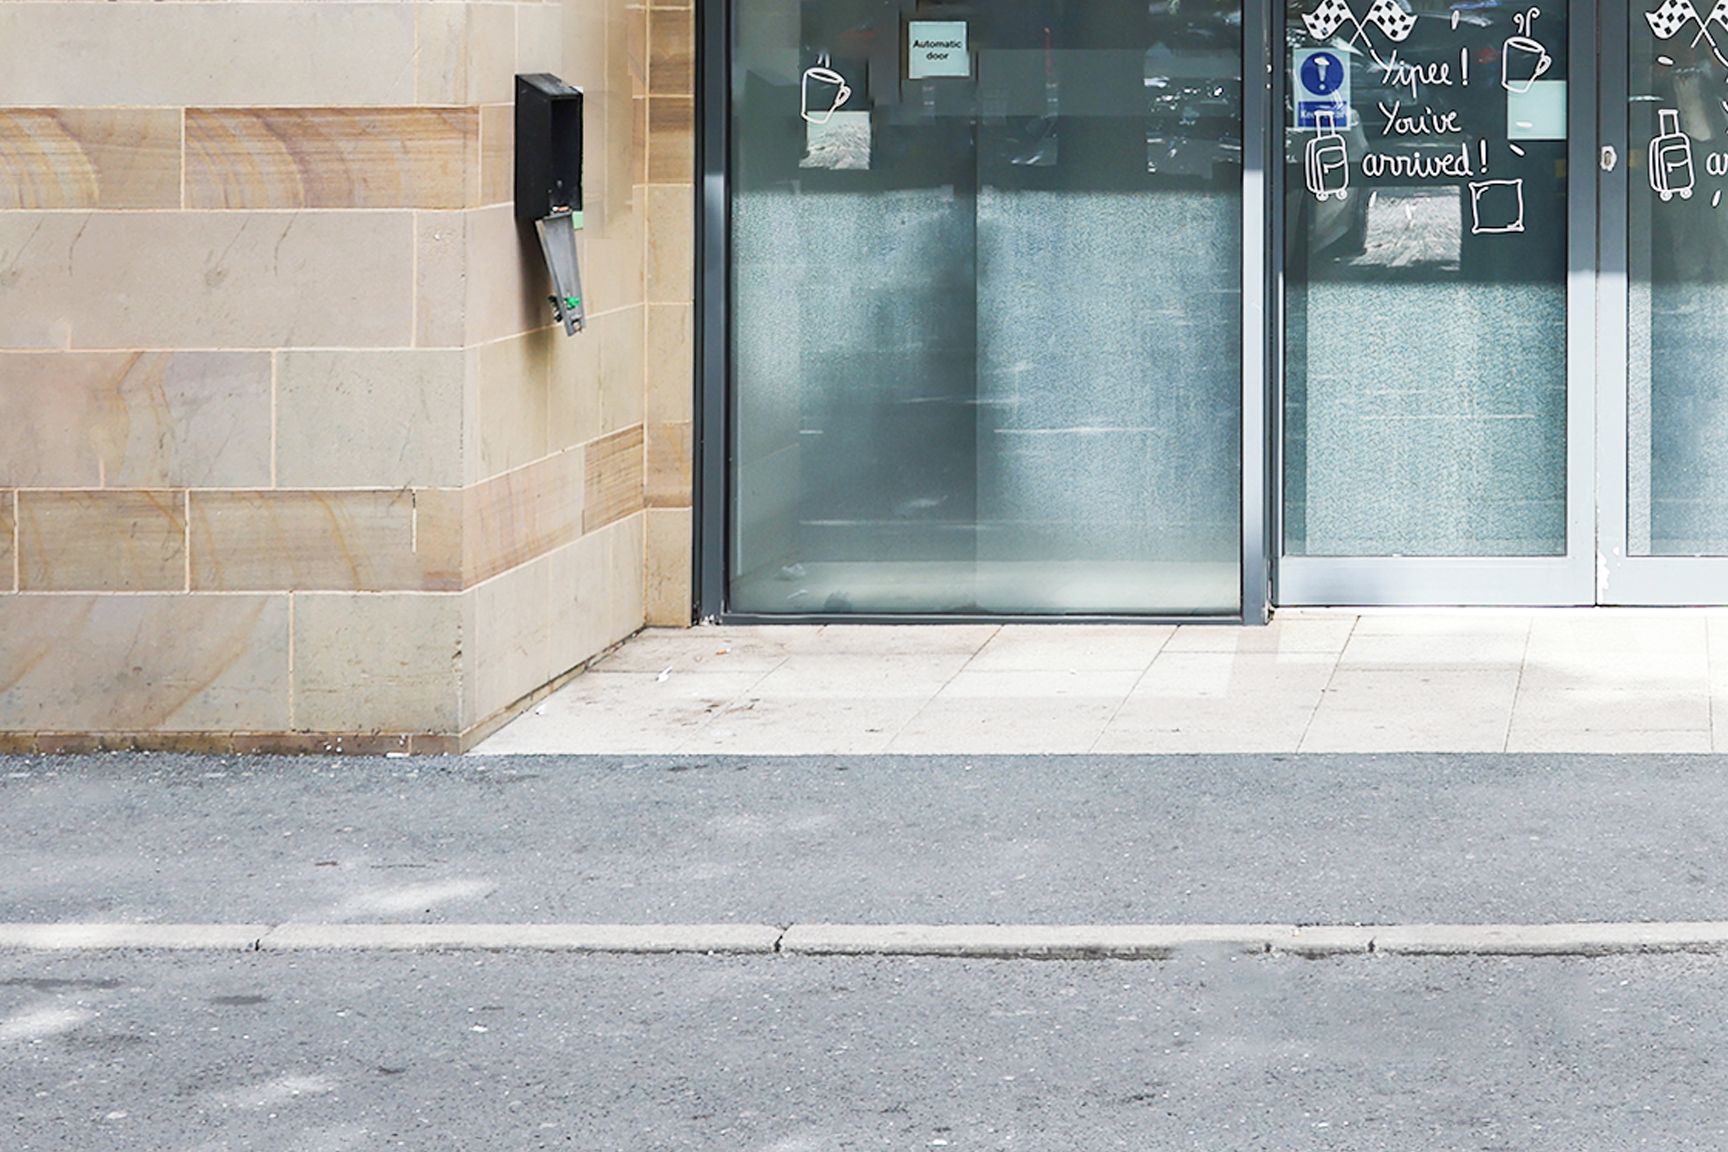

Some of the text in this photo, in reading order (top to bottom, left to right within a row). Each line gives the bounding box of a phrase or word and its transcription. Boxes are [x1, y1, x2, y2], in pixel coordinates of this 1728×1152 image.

[913, 40, 961, 48] Automatic
[926, 52, 949, 60] door
[1379, 101, 1462, 135] You've
